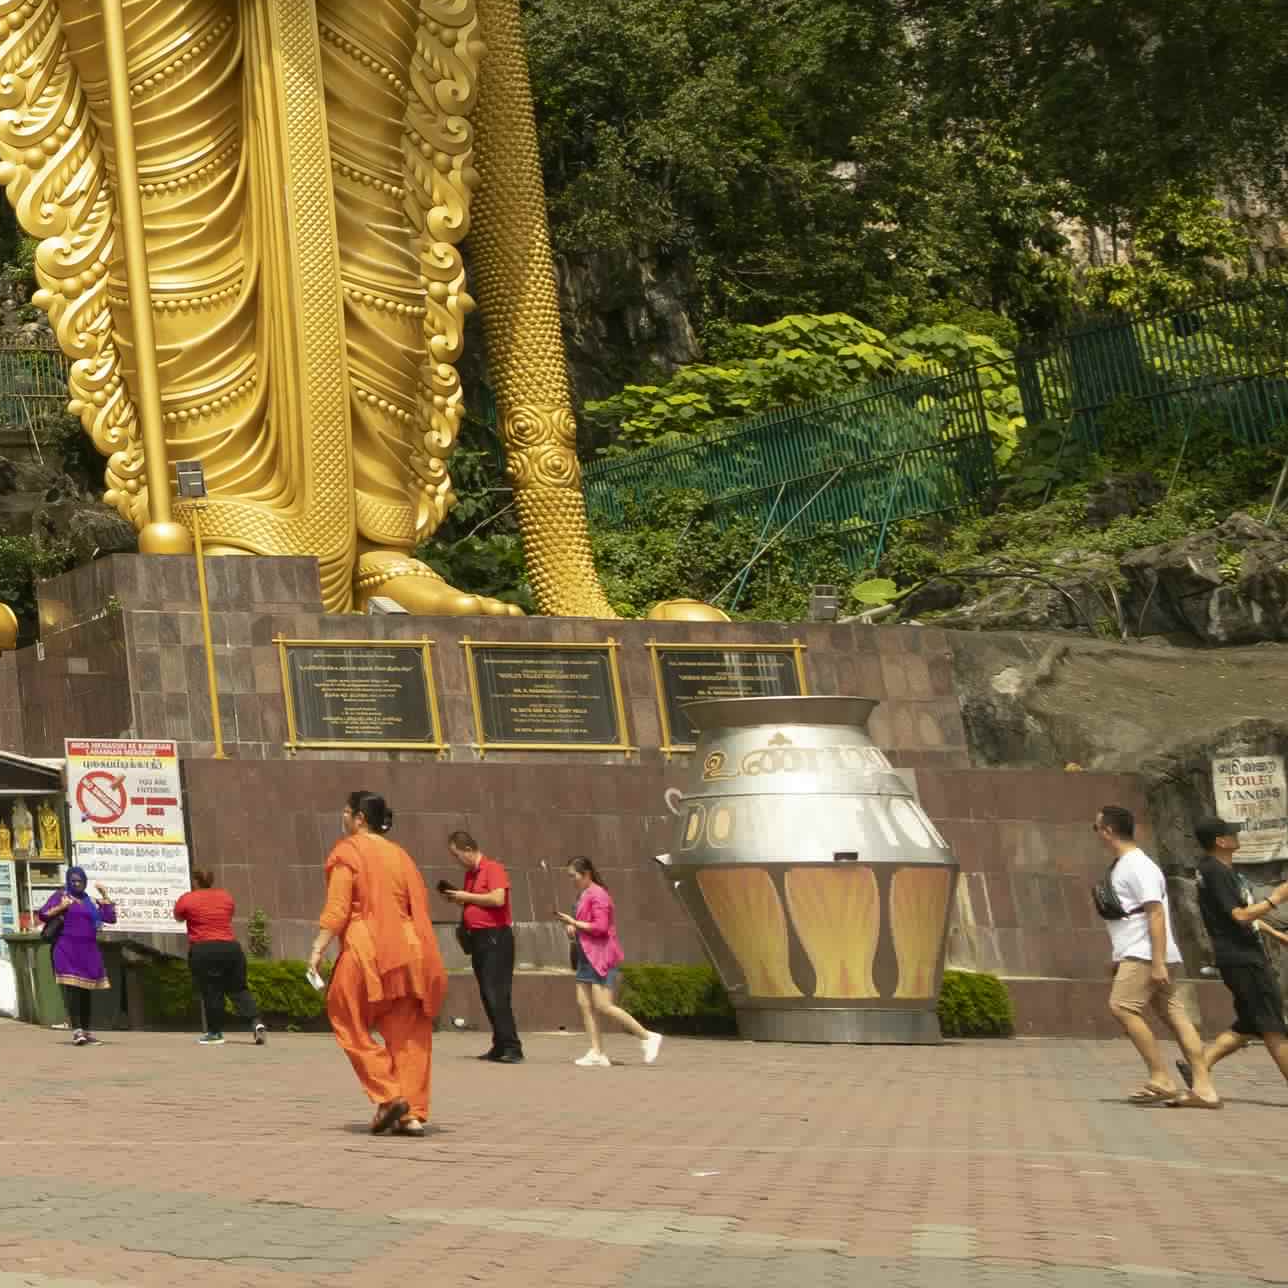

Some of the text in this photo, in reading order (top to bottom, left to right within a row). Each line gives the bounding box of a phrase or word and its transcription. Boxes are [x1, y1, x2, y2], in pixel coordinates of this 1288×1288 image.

[1226, 774, 1273, 786] TOILET
[1224, 788, 1281, 801] TANDAS
[147, 887, 169, 896] GATE
